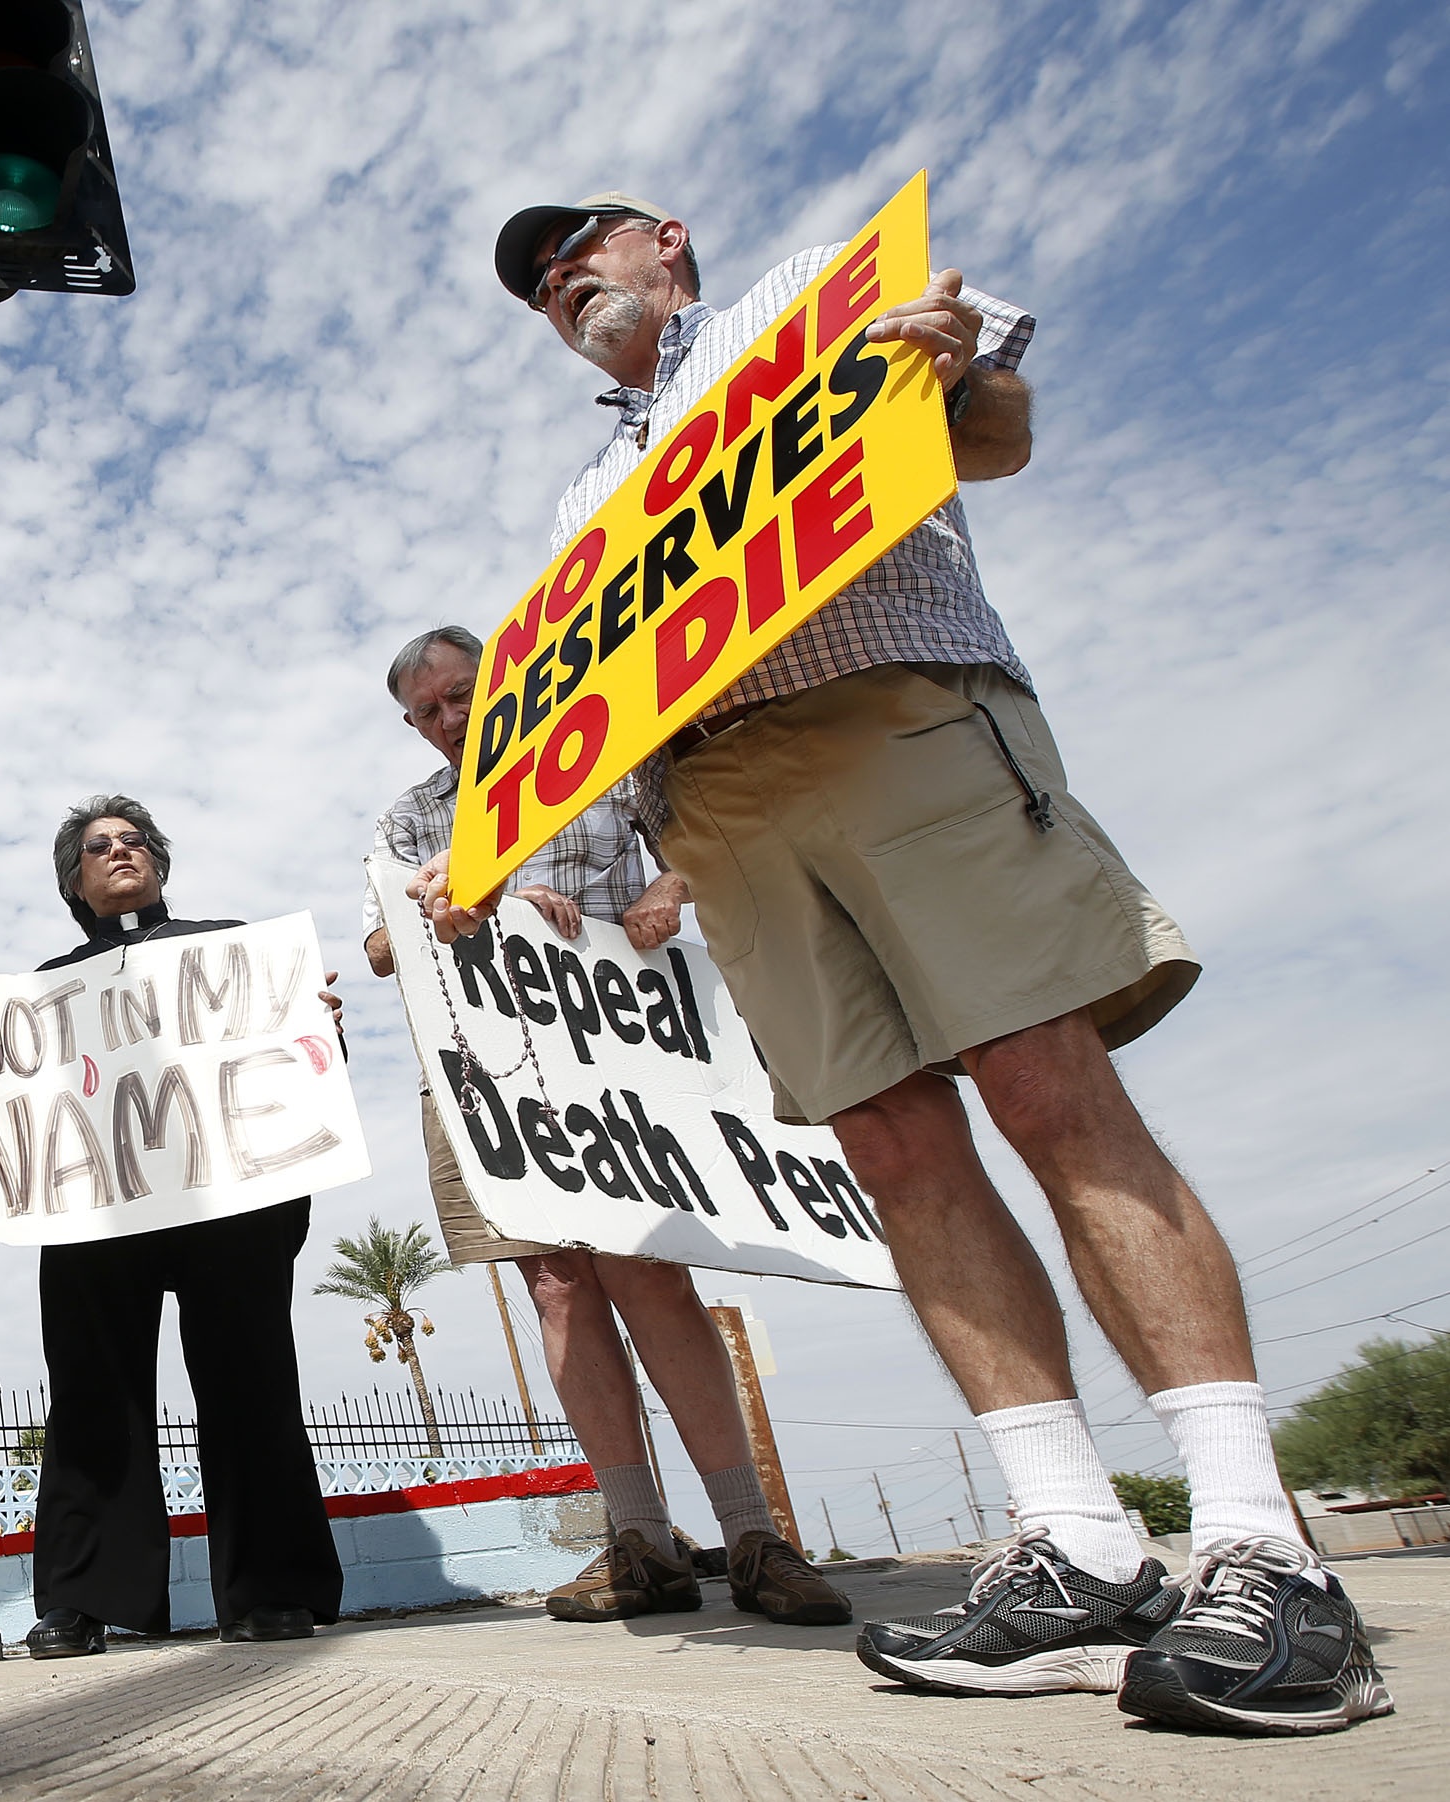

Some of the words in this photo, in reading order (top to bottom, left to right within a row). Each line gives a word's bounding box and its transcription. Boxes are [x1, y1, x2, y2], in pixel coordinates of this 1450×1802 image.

[475, 320, 888, 786] DESERVES
[488, 527, 606, 700] NO
[643, 230, 880, 516] ONE
[486, 693, 610, 859] TO
[655, 437, 874, 717] DIE
[100, 976, 161, 1052] IN
[177, 941, 306, 1046] MY
[439, 1049, 720, 1216] Death
[451, 917, 712, 1064] Repeal
